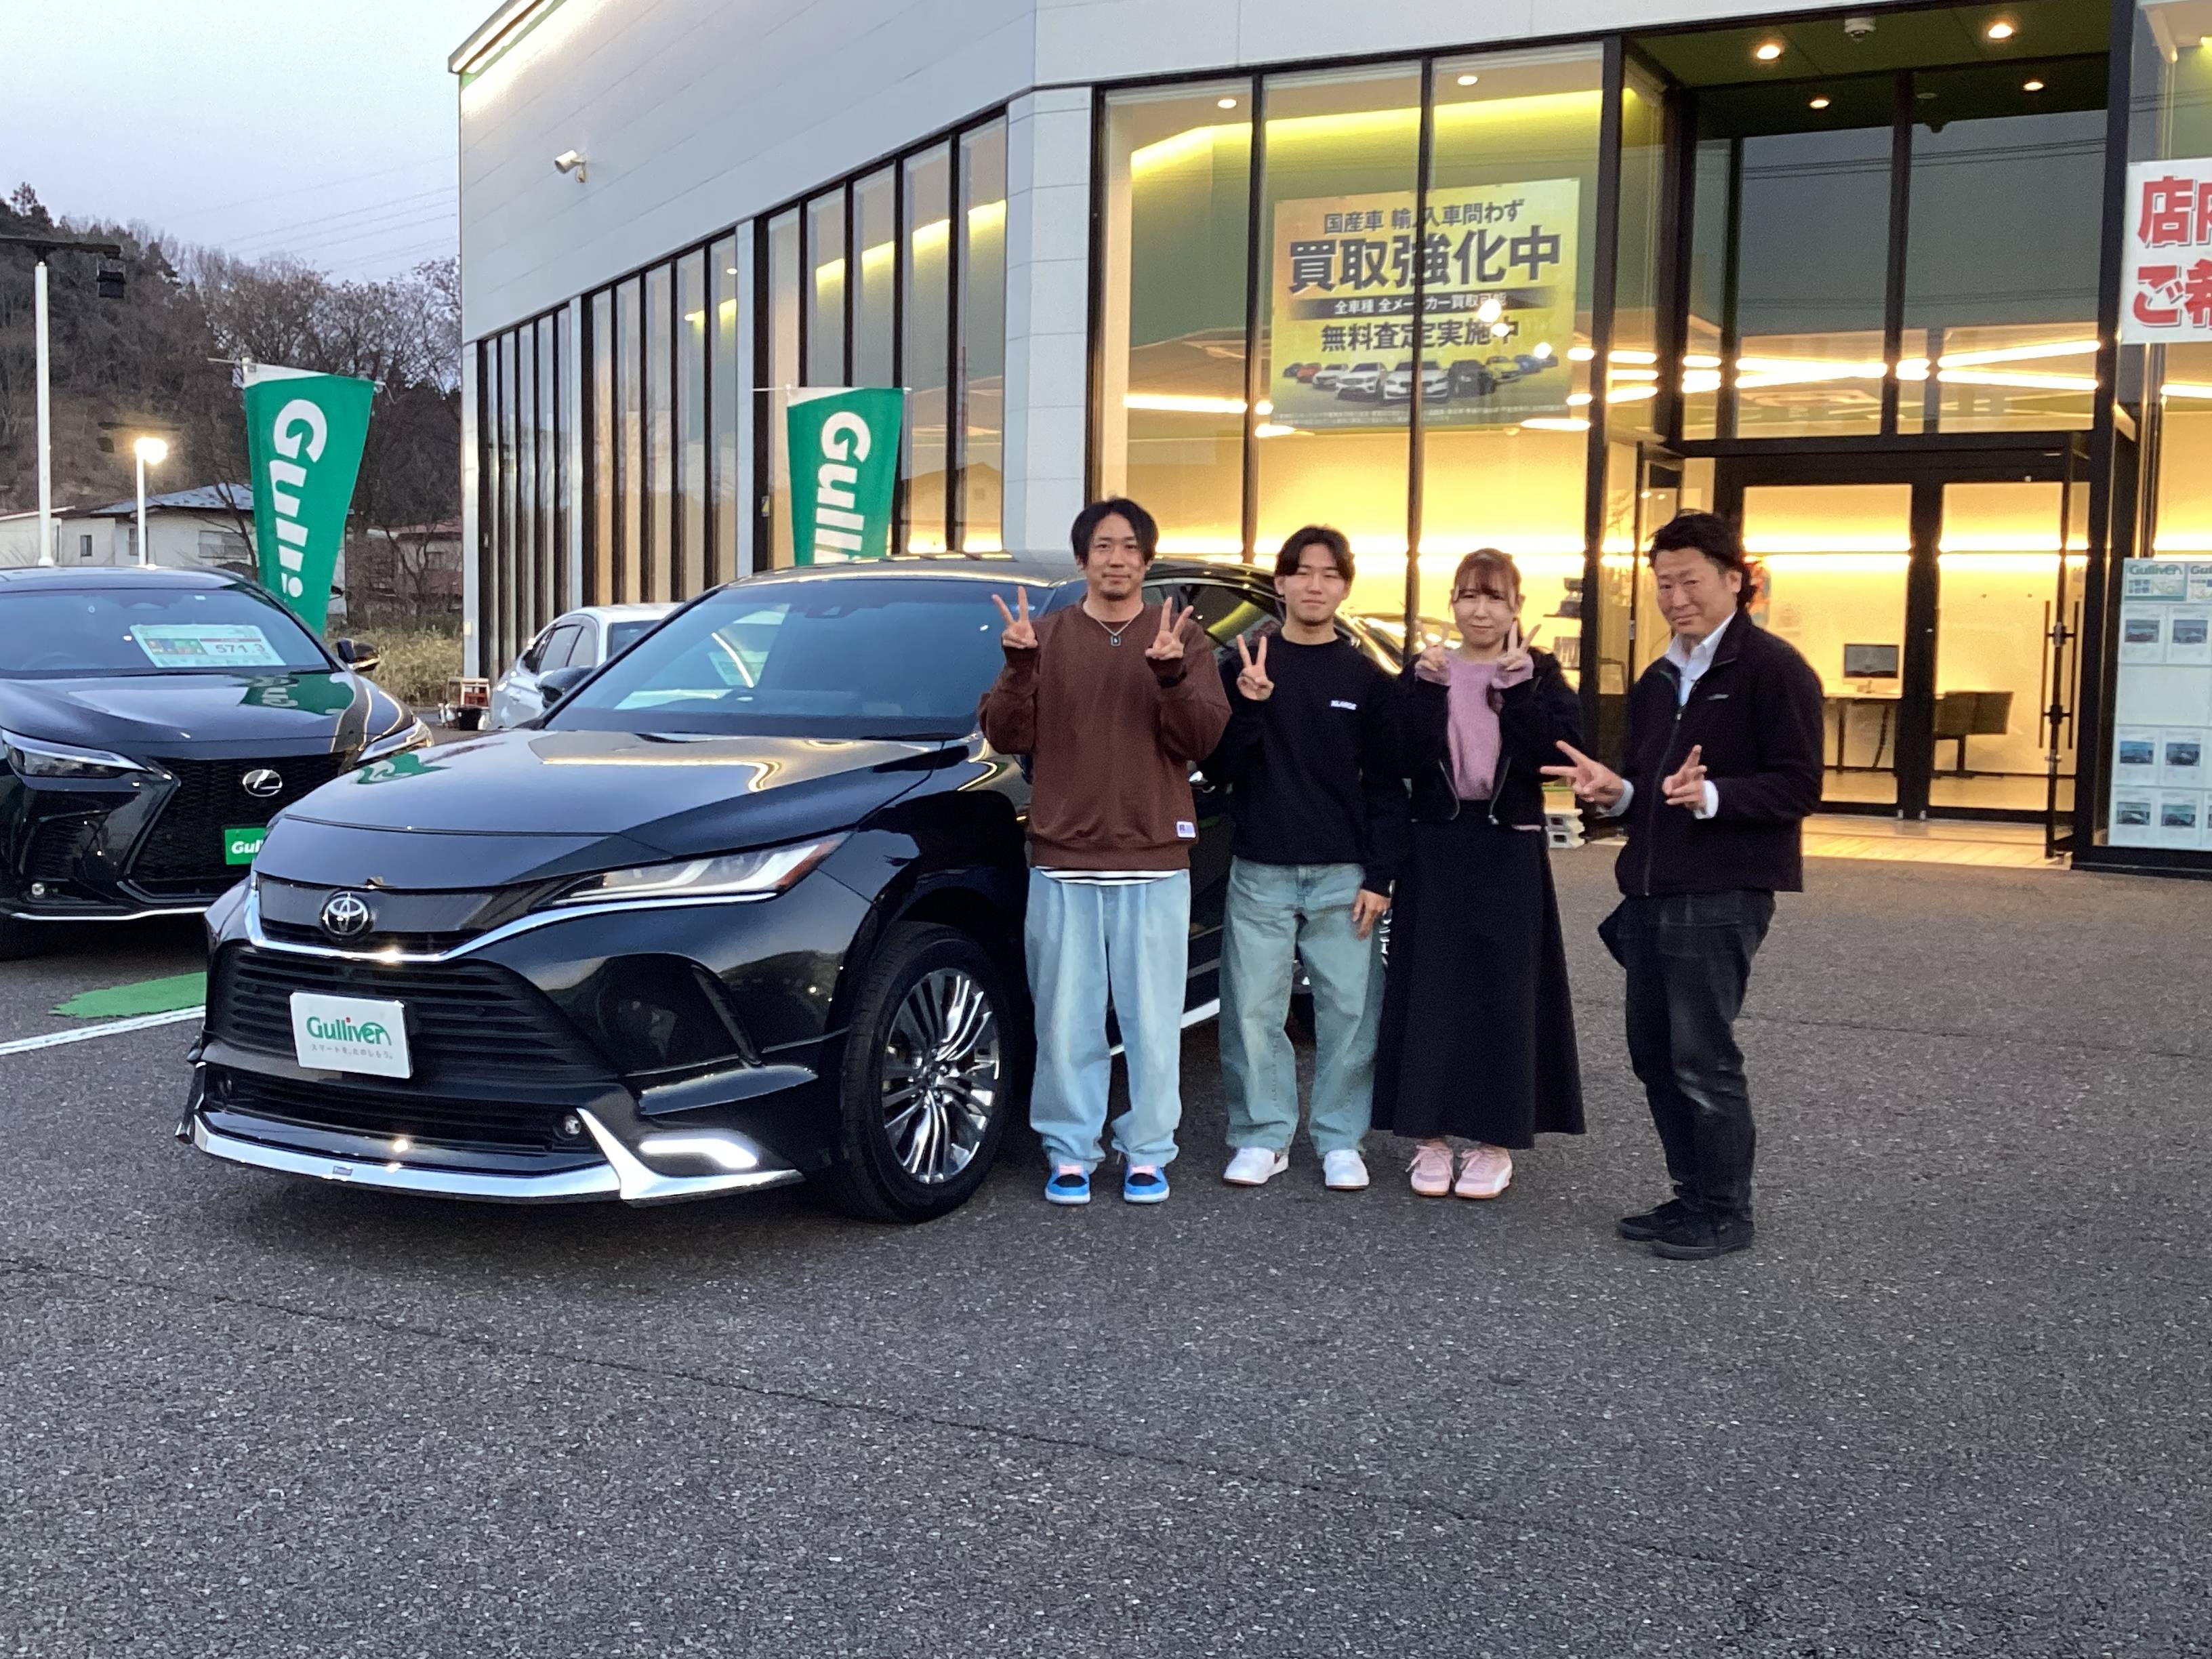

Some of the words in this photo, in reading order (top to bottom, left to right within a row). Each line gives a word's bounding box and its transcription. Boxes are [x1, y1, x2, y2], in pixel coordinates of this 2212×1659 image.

[1324, 209, 1384, 234] 国産車
[1391, 199, 1525, 230] 輸入車問わず
[1288, 224, 1561, 294] 買取強化中
[1334, 298, 1374, 314] 全車種
[1322, 315, 1519, 352] 無料査定実施中
[306, 1017, 392, 1046] Gulliver
